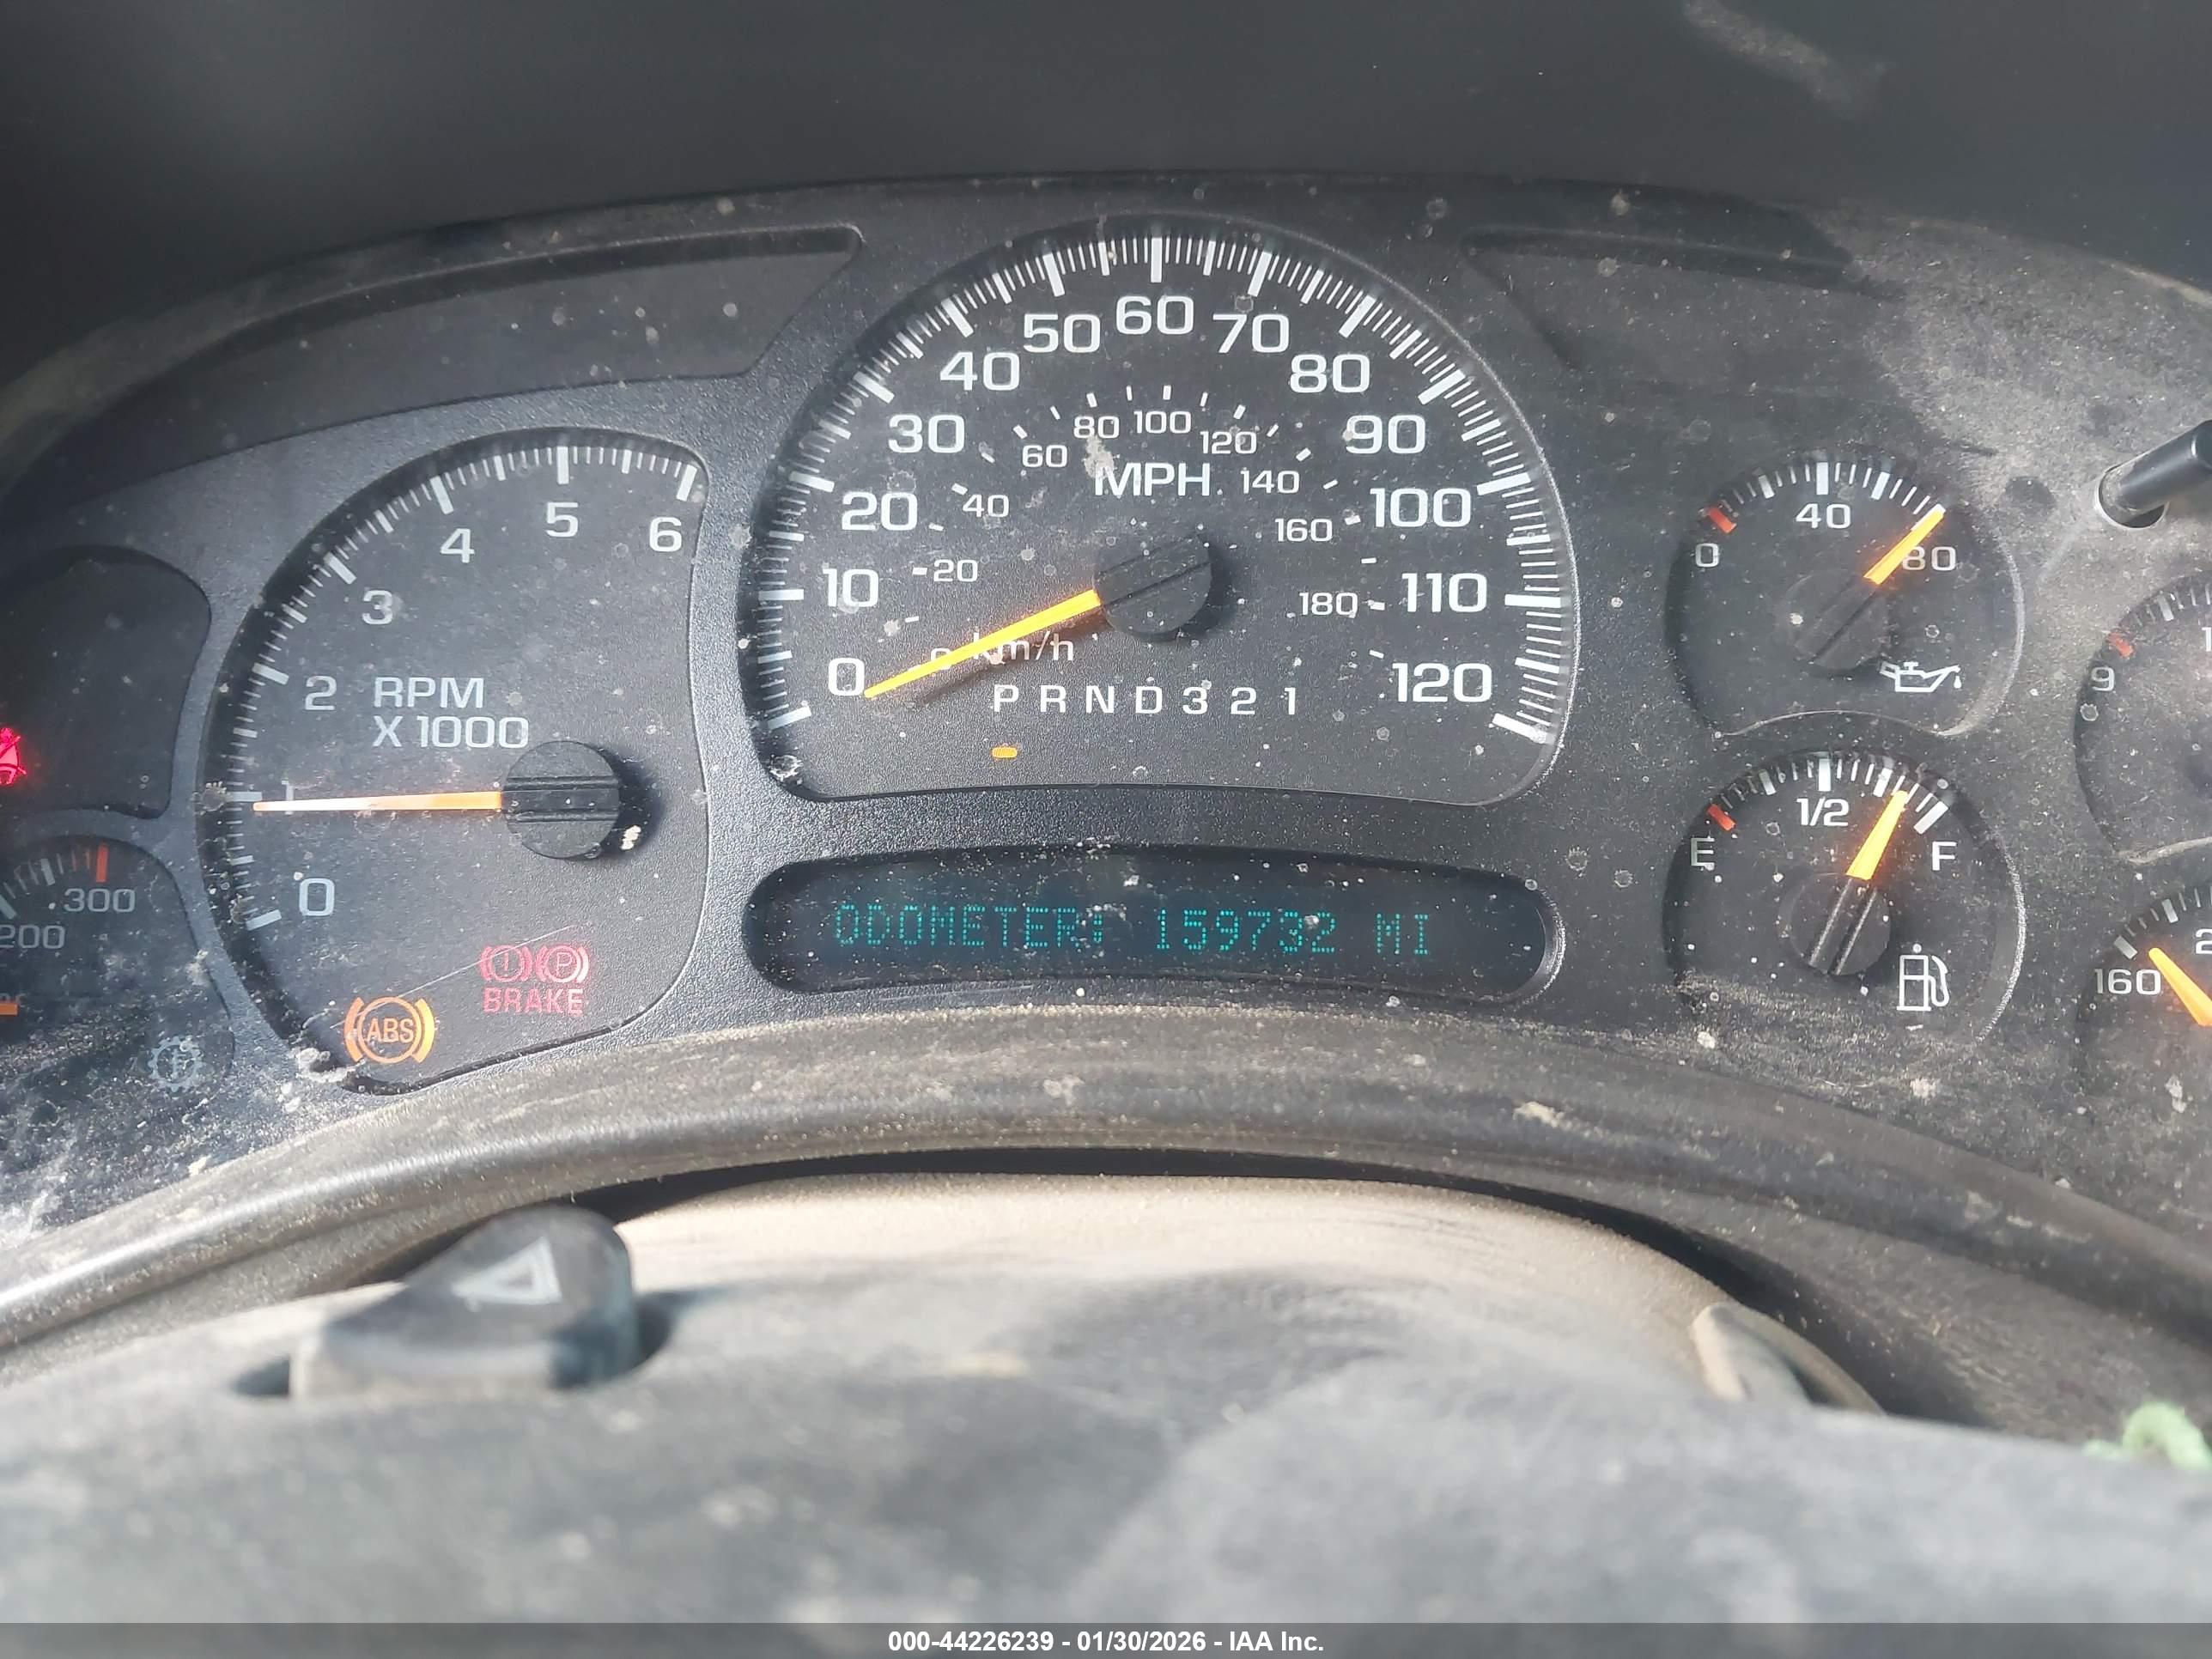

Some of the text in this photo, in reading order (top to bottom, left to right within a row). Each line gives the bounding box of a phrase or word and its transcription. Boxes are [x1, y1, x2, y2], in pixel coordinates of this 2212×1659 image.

[1115, 295, 1194, 335] 60
[1023, 314, 1100, 353] 50
[1213, 314, 1289, 353] 70
[939, 352, 1019, 391] 40
[1291, 354, 1370, 393] 80
[888, 415, 964, 453] 30
[1074, 416, 1120, 439] 80
[1133, 410, 1191, 434] 100
[1346, 415, 1425, 454] 90
[1023, 445, 1067, 468] 60
[1201, 432, 1256, 454] 120
[1094, 462, 1210, 498] MPH
[1241, 471, 1299, 494] 140
[546, 501, 579, 537] 5
[842, 492, 918, 532] 20
[963, 495, 1009, 517] 40
[1370, 489, 1471, 527] 100
[1796, 503, 1850, 528] 40
[441, 528, 475, 563] 4
[649, 517, 682, 552] 6
[1275, 519, 1333, 542] 160
[933, 560, 978, 582] 20
[1695, 543, 1718, 568] 0
[1902, 546, 1956, 571] 80
[823, 568, 878, 607] 10
[1402, 573, 1487, 613] 110
[362, 589, 394, 625] 3
[1299, 592, 1358, 616] 180
[374, 678, 483, 708] RPM
[829, 659, 865, 696] 0
[1392, 663, 1492, 702] 120
[2092, 667, 2116, 692] 9
[306, 677, 337, 711] 2
[994, 684, 1295, 714] P R N D 3 2 1
[374, 716, 529, 749] X 1000
[1797, 799, 1849, 826] 1/2
[1691, 838, 1715, 866] E
[1932, 842, 1956, 871] F
[64, 888, 136, 912] 300
[299, 878, 335, 916] 0
[836, 904, 1429, 955] ODOMETER: 159732 MI
[2094, 968, 2161, 995] 160
[483, 987, 584, 1016] BRAKE
[367, 1018, 414, 1044] ABS
